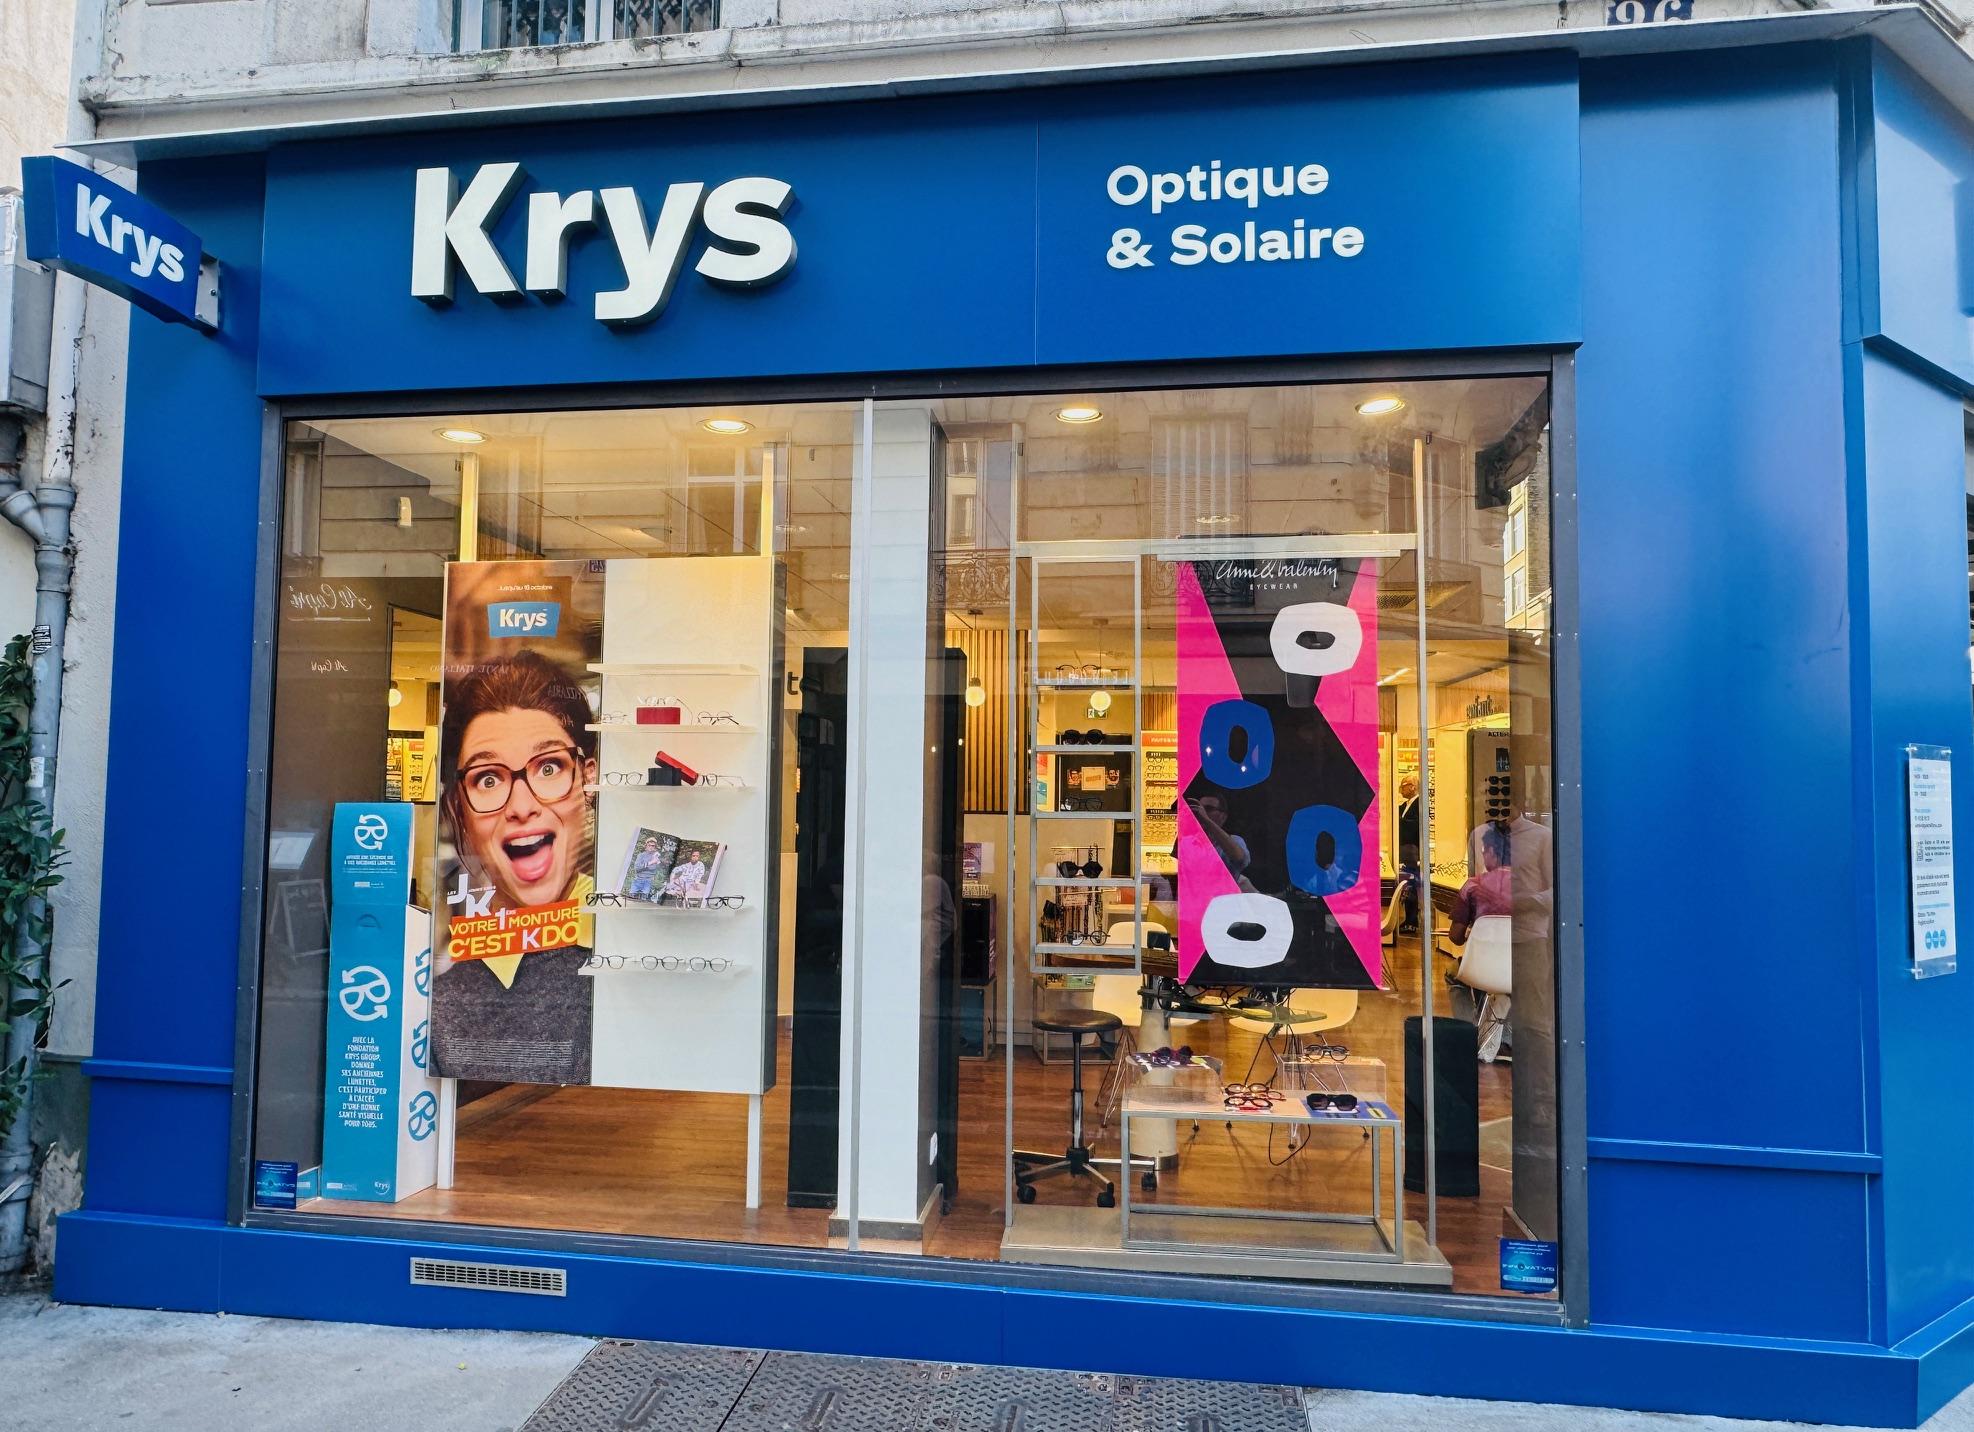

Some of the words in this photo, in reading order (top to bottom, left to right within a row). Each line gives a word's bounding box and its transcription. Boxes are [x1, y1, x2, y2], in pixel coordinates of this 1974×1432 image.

[1106, 159, 1330, 214] Optique
[76, 182, 185, 283] Krys
[411, 161, 796, 324] Krys
[1106, 227, 1155, 269] &
[1169, 218, 1365, 266] Solaire
[500, 608, 548, 631] Krys
[448, 919, 498, 936] VOTRE
[509, 905, 581, 929] MONTURE
[448, 932, 517, 958] C'EST
[522, 921, 580, 950] KDO
